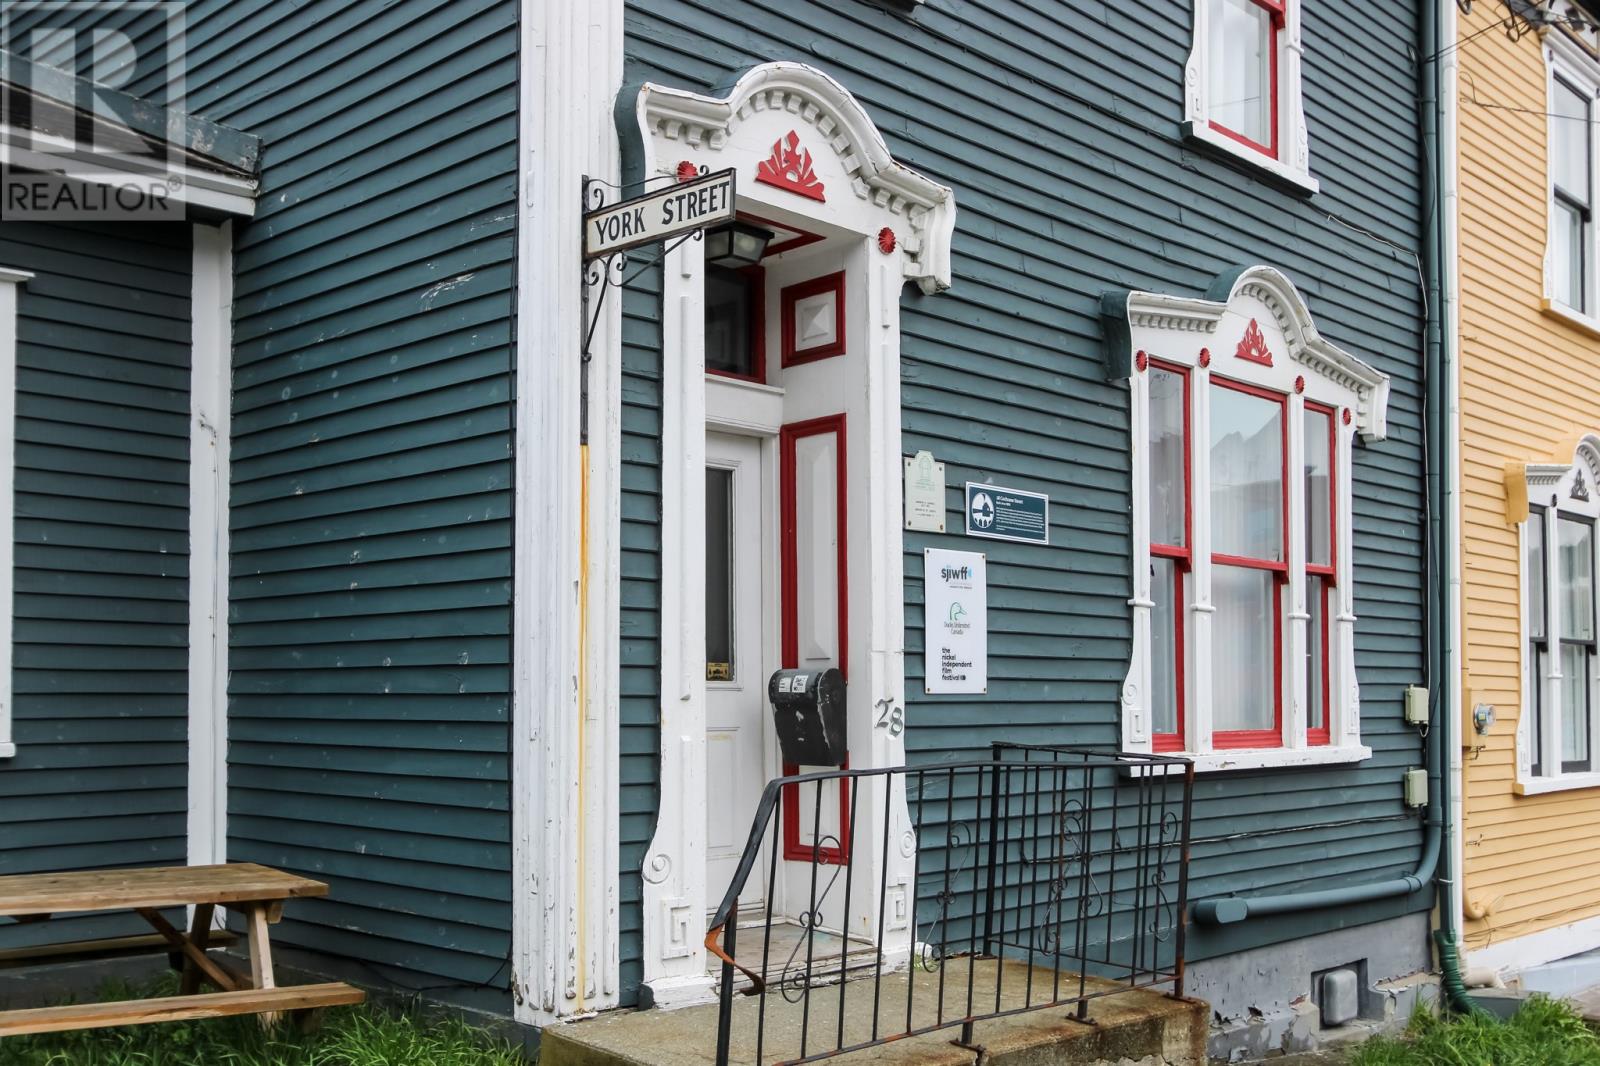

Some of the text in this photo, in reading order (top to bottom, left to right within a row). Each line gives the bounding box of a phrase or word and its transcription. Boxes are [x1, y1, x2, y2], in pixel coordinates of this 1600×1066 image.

[595, 181, 730, 245] YORK STREET
[941, 564, 968, 582] sjiwff
[874, 697, 904, 737] 28
